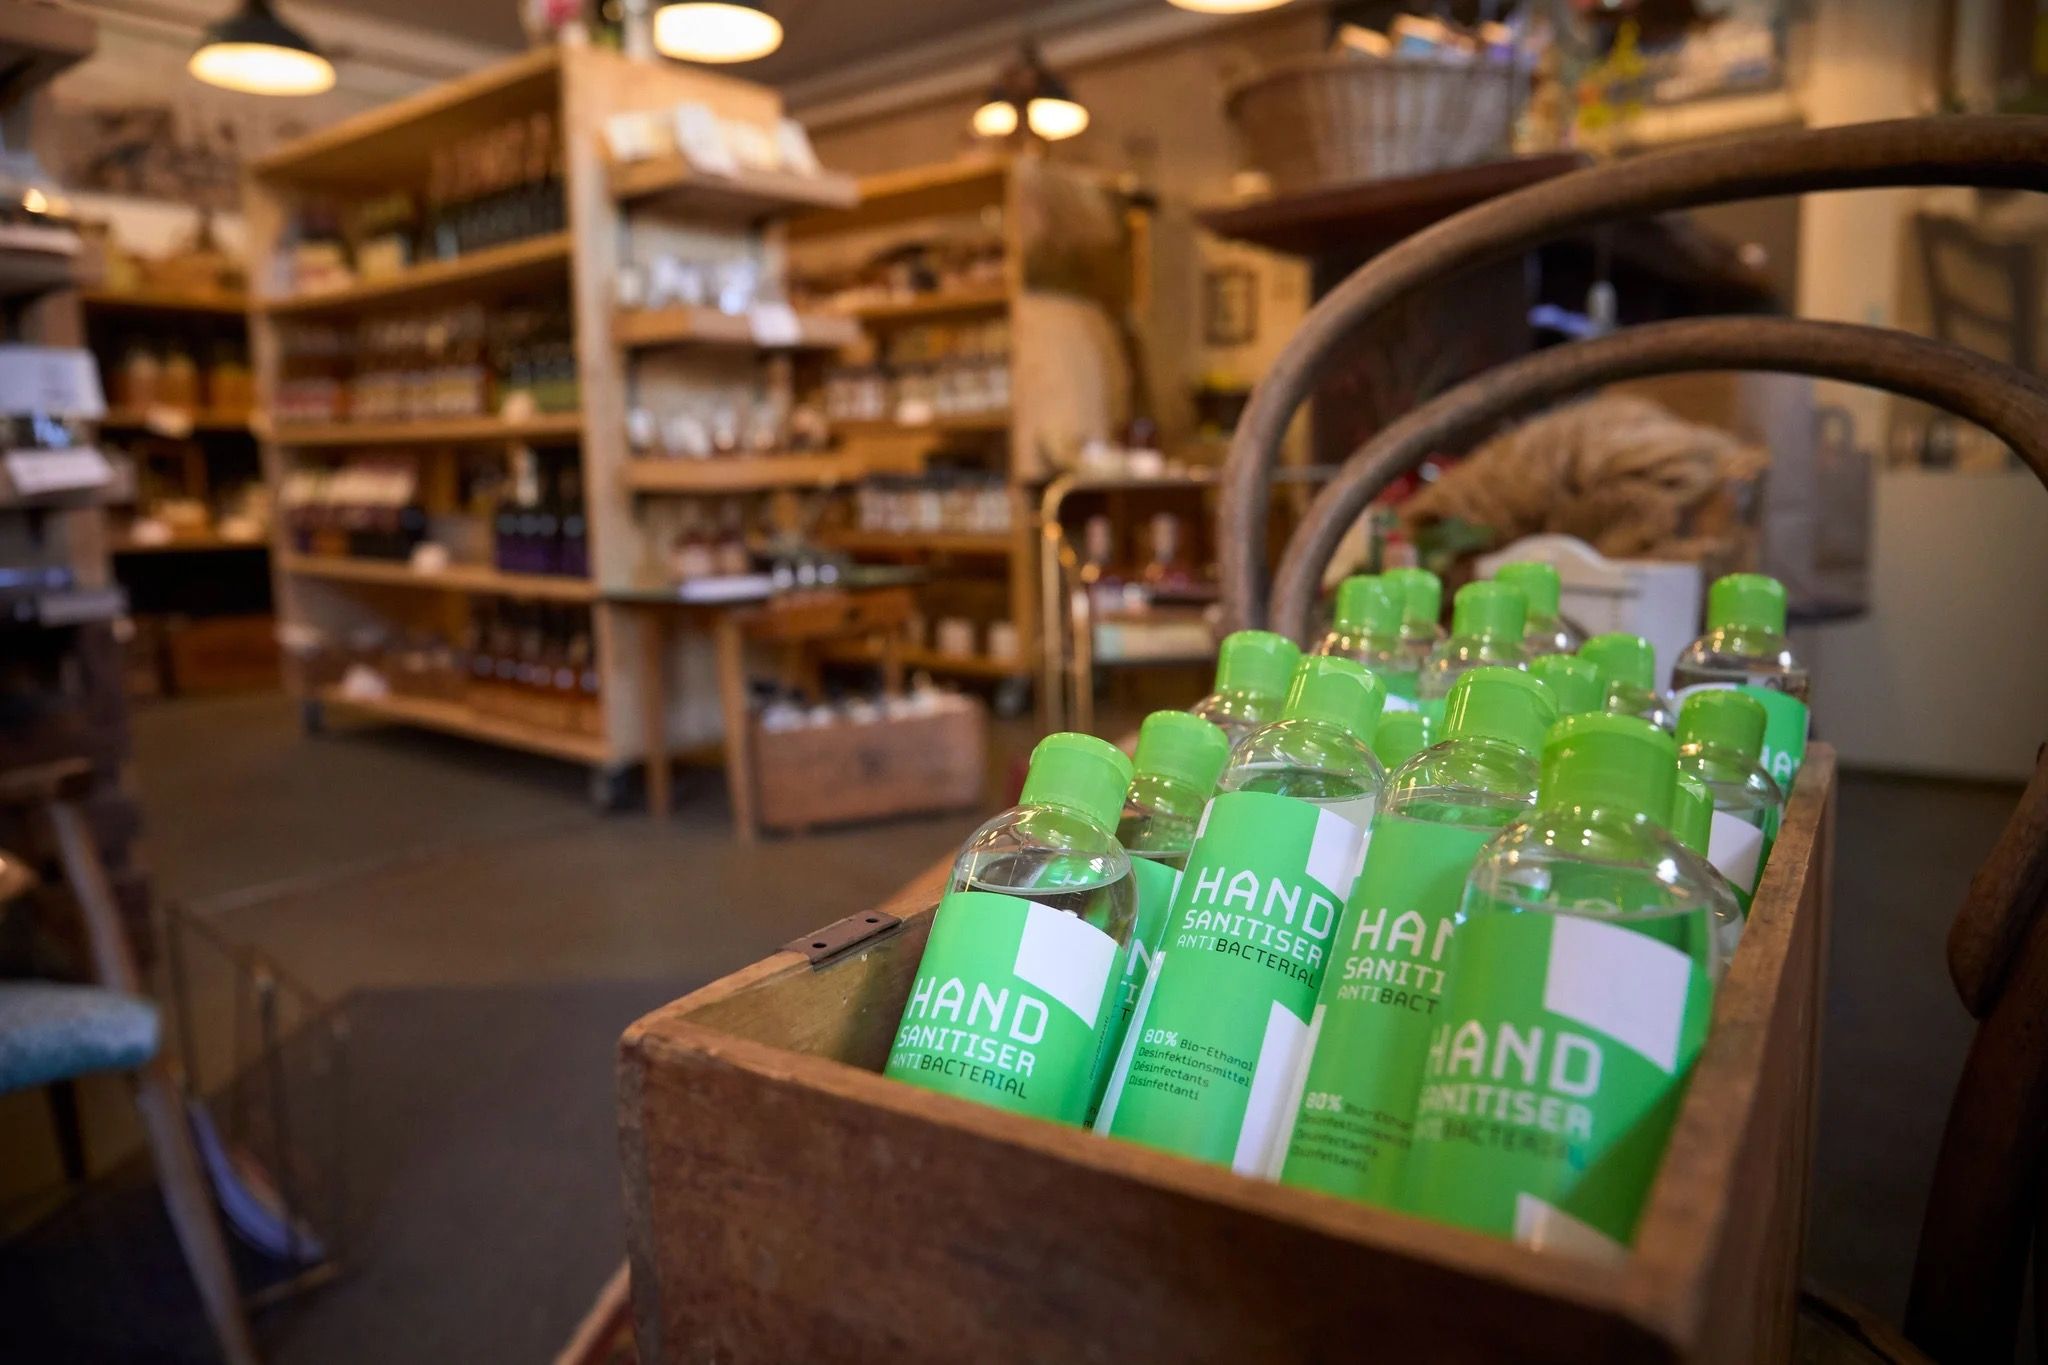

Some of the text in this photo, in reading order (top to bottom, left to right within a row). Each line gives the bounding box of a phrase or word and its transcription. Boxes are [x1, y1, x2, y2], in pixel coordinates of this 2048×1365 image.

[1191, 866, 1335, 940] HAND
[1176, 934, 1316, 990] ANTIBACTERIAL
[1182, 909, 1324, 970] SANITISER
[907, 976, 1049, 1045] HAND
[892, 1052, 1028, 1100] ANTIBACTERIAL
[897, 1024, 1036, 1078] SANITISER
[1133, 1060, 1210, 1089] Désinfectants
[1138, 1046, 1250, 1088] Desinfektionsmittel
[1144, 1028, 1254, 1072] 80% Bio-Ethanol
